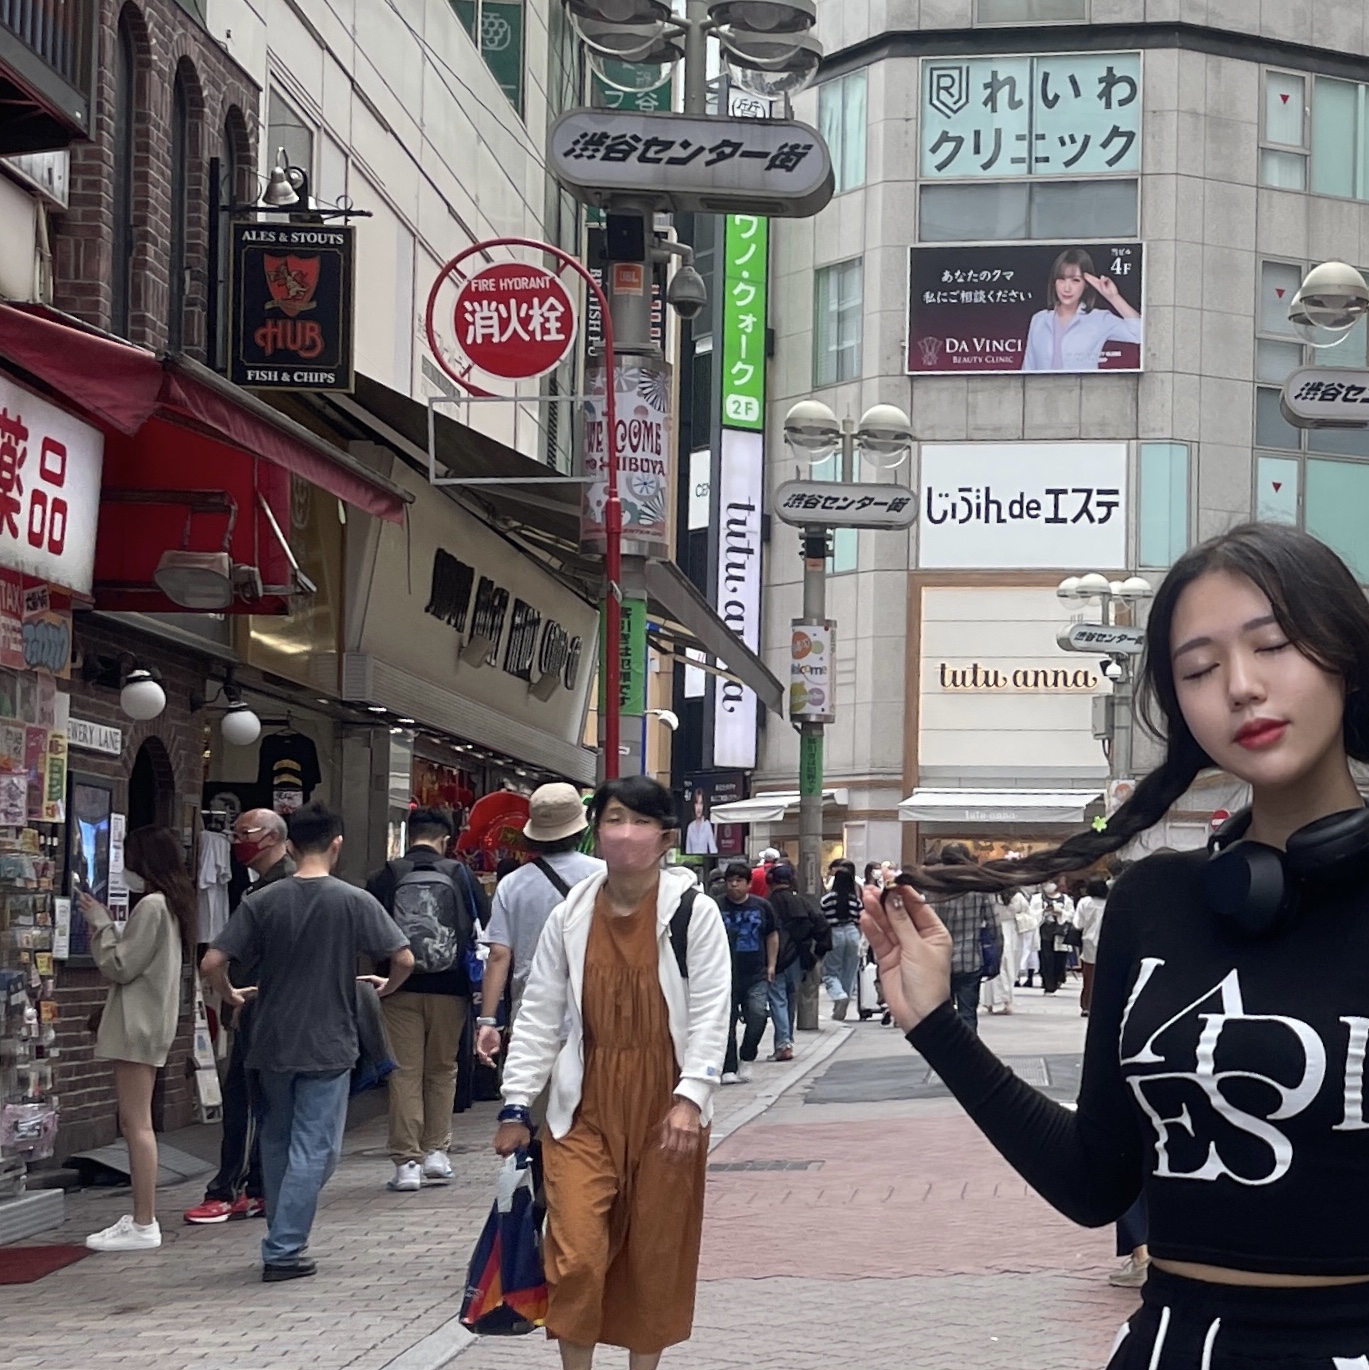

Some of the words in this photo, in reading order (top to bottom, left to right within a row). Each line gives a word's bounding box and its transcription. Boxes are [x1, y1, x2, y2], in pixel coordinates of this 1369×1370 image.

[982, 66, 1138, 113] れいわ
[563, 131, 814, 172] 渋谷センター街
[929, 125, 1136, 172] クリニック
[242, 231, 276, 242] ALES
[279, 231, 288, 242] &
[290, 232, 345, 245] STOUTS
[942, 269, 1014, 283] あなたのクマ
[1110, 258, 1132, 275] 4F
[471, 278, 497, 292] FIRE
[499, 276, 551, 291] HYDRANT
[923, 289, 1033, 304] 私にご相談ください
[463, 296, 566, 345] 消火栓
[254, 318, 325, 359] HUB
[945, 338, 970, 353] DA
[974, 338, 1023, 353] VINCI
[952, 355, 983, 364] BEAUTY
[984, 355, 1014, 364] CLINIC
[247, 369, 278, 382] FISH
[281, 371, 291, 382] &
[293, 371, 336, 384] CHIPS
[731, 400, 754, 416] 2F
[586, 419, 661, 456] WECOME
[783, 493, 912, 514] 渋谷センター街
[724, 496, 756, 594] tutu
[940, 663, 1007, 688] tutu
[1012, 668, 1098, 688] anna
